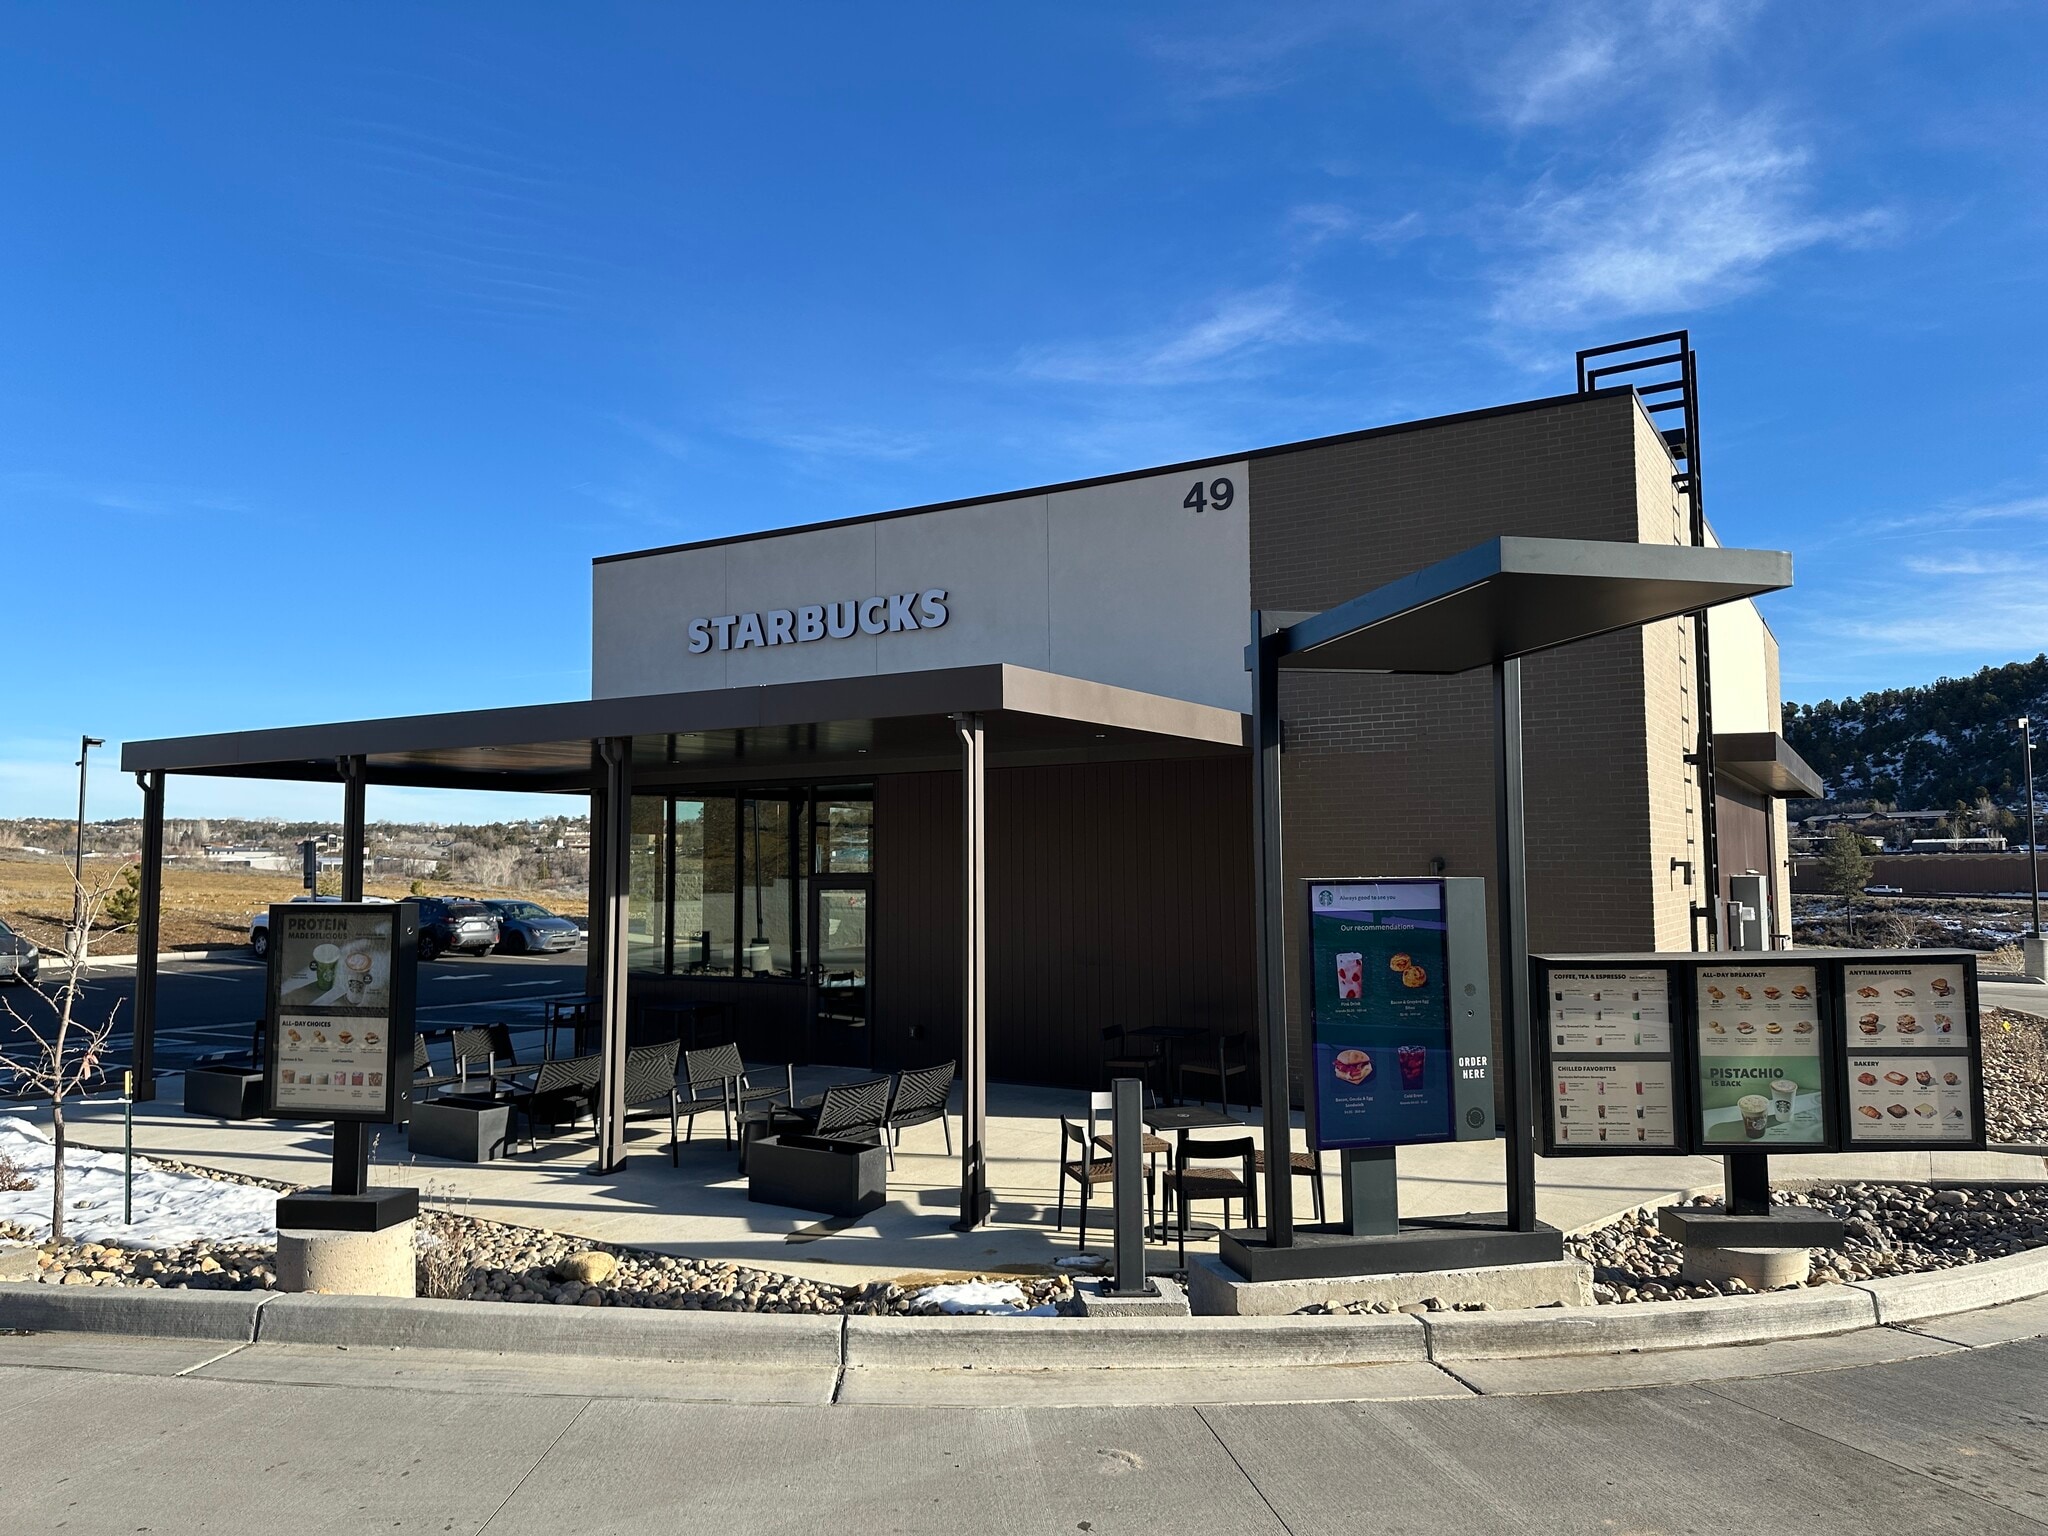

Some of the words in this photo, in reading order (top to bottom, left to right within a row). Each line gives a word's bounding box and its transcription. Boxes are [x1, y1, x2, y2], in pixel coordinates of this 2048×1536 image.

[1184, 477, 1234, 513] 49
[688, 588, 948, 654] STARBUCKS
[288, 918, 347, 930] PROTEIN
[310, 932, 348, 940] DELICIOUS
[1458, 1056, 1487, 1067] ORDER
[1462, 1069, 1485, 1079] HERE
[1710, 1068, 1784, 1078] PISTACHIO
